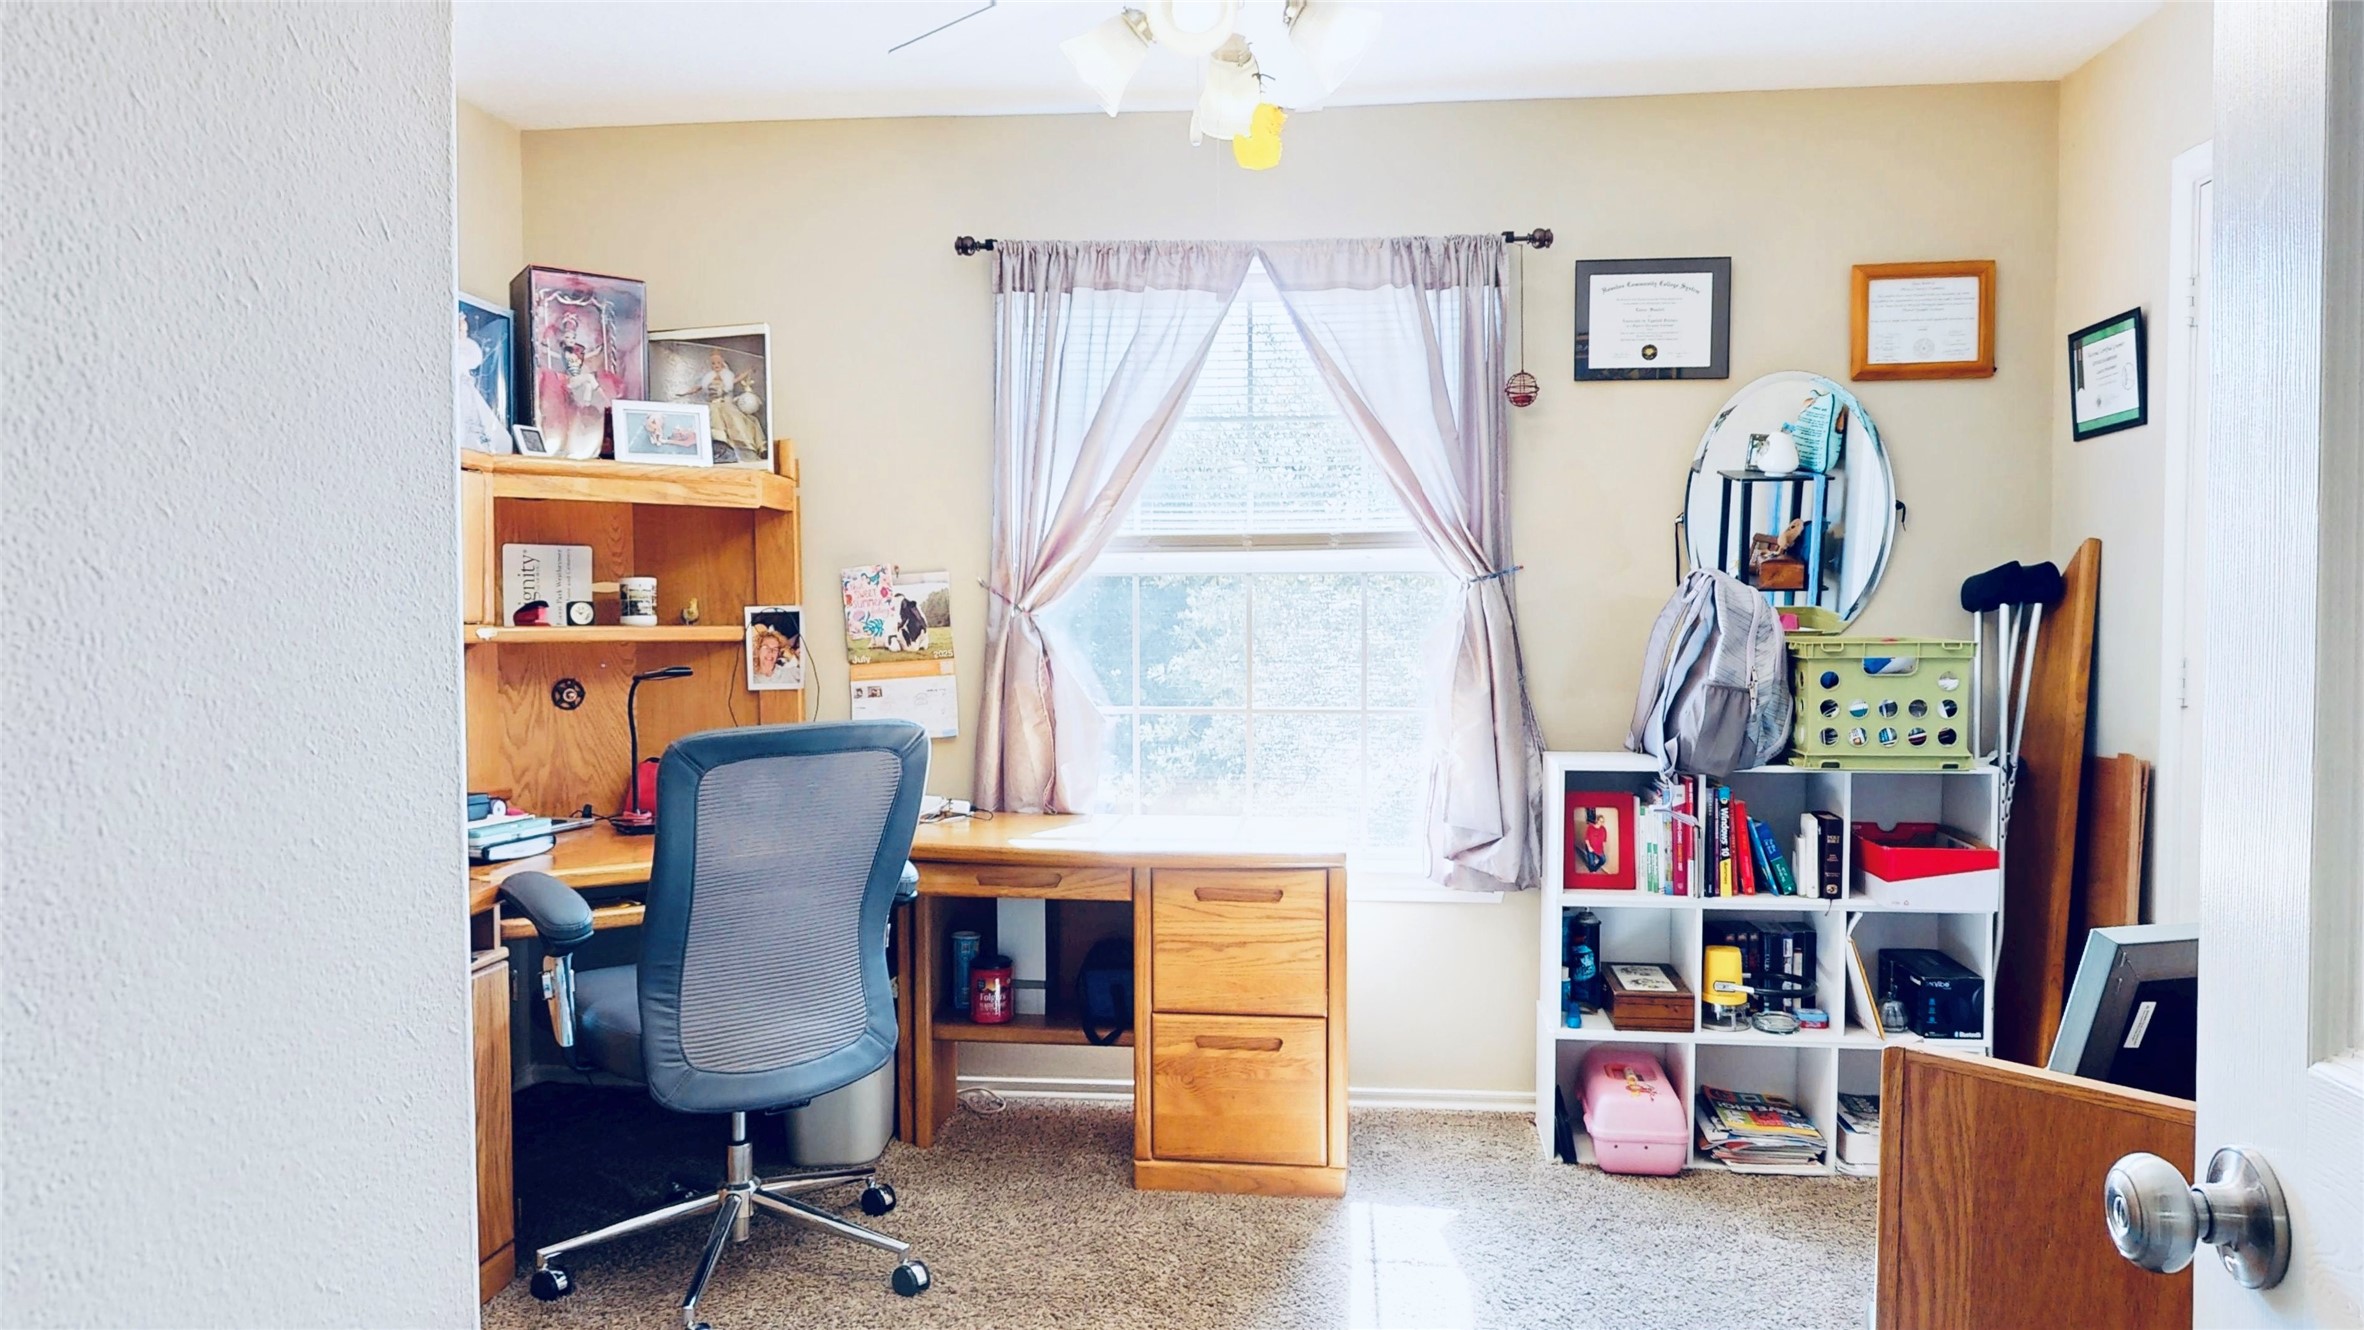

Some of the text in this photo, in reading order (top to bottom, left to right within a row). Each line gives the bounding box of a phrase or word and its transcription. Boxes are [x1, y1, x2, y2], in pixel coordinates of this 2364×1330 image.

[1680, 283, 1700, 294] System
[851, 650, 953, 664] July 2025
[1720, 807, 1730, 857] Windows 10
